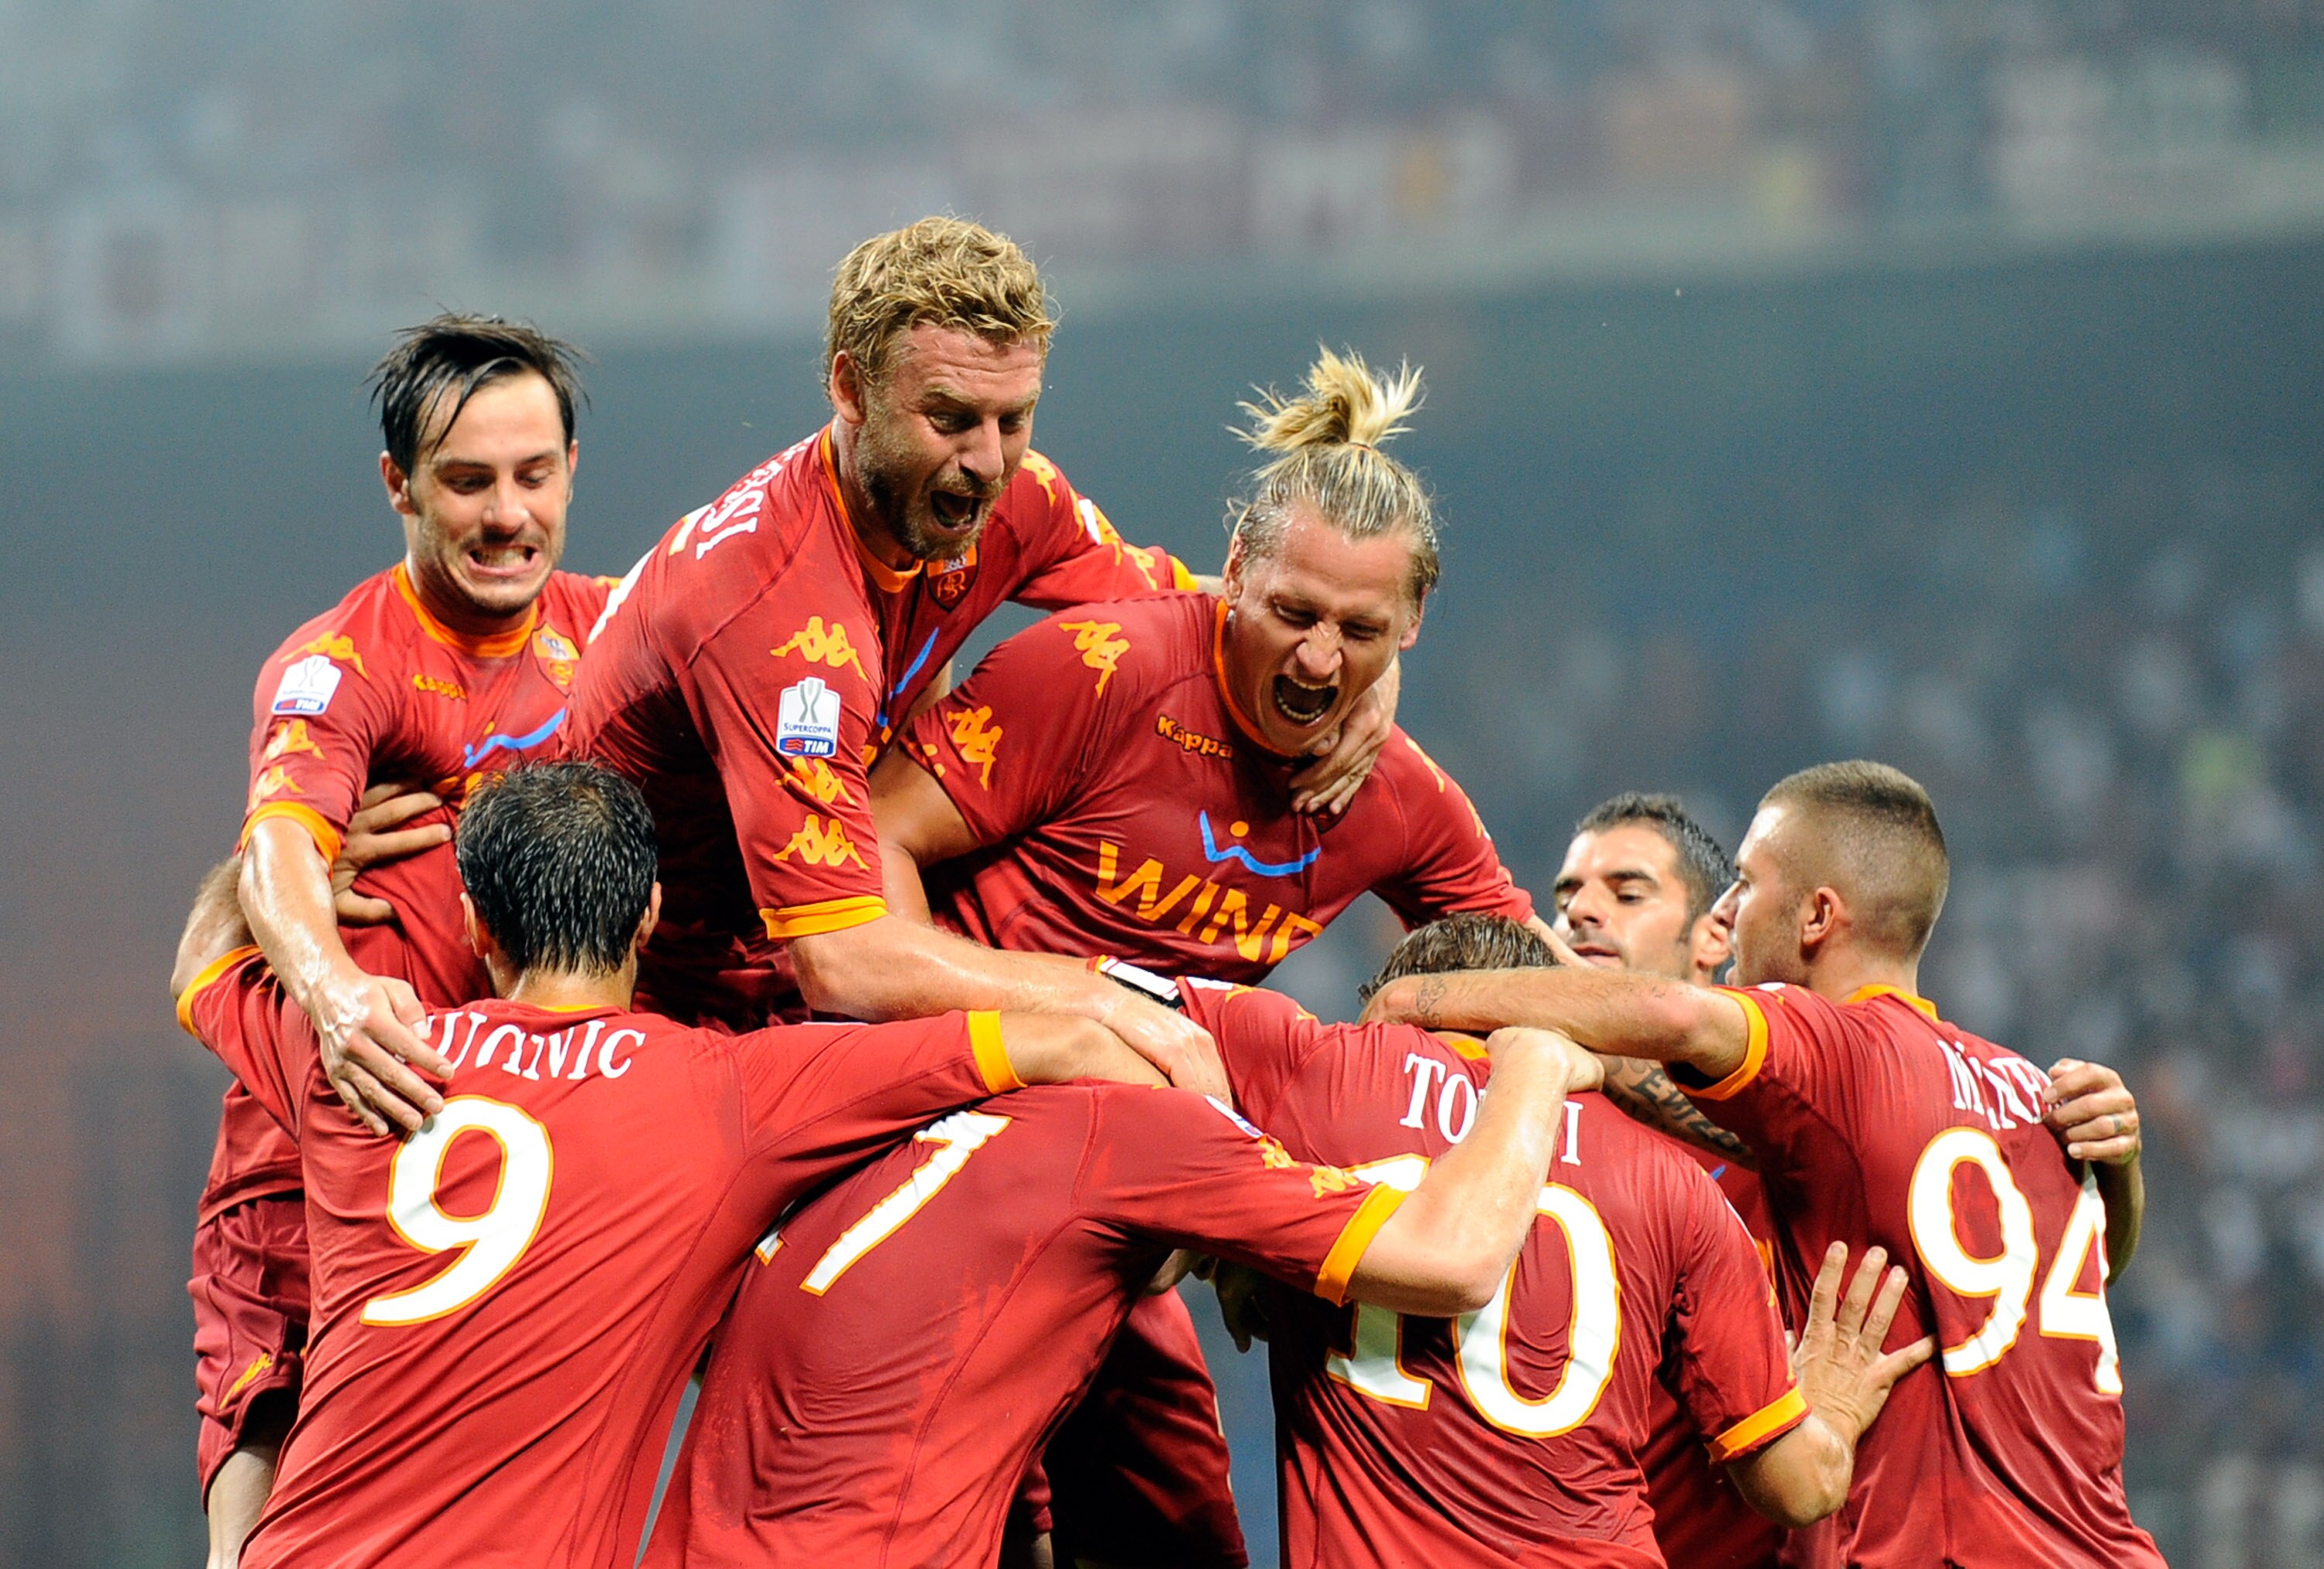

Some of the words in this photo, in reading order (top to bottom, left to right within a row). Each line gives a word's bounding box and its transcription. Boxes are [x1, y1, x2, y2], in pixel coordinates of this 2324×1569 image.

[783, 723, 832, 733] SUPERCOPPA
[804, 740, 830, 754] TIM
[1157, 715, 1235, 760] Kappa
[1399, 1052, 1584, 1166] TOI
[360, 1095, 554, 1327] 9
[1907, 1126, 2123, 1395] 94
